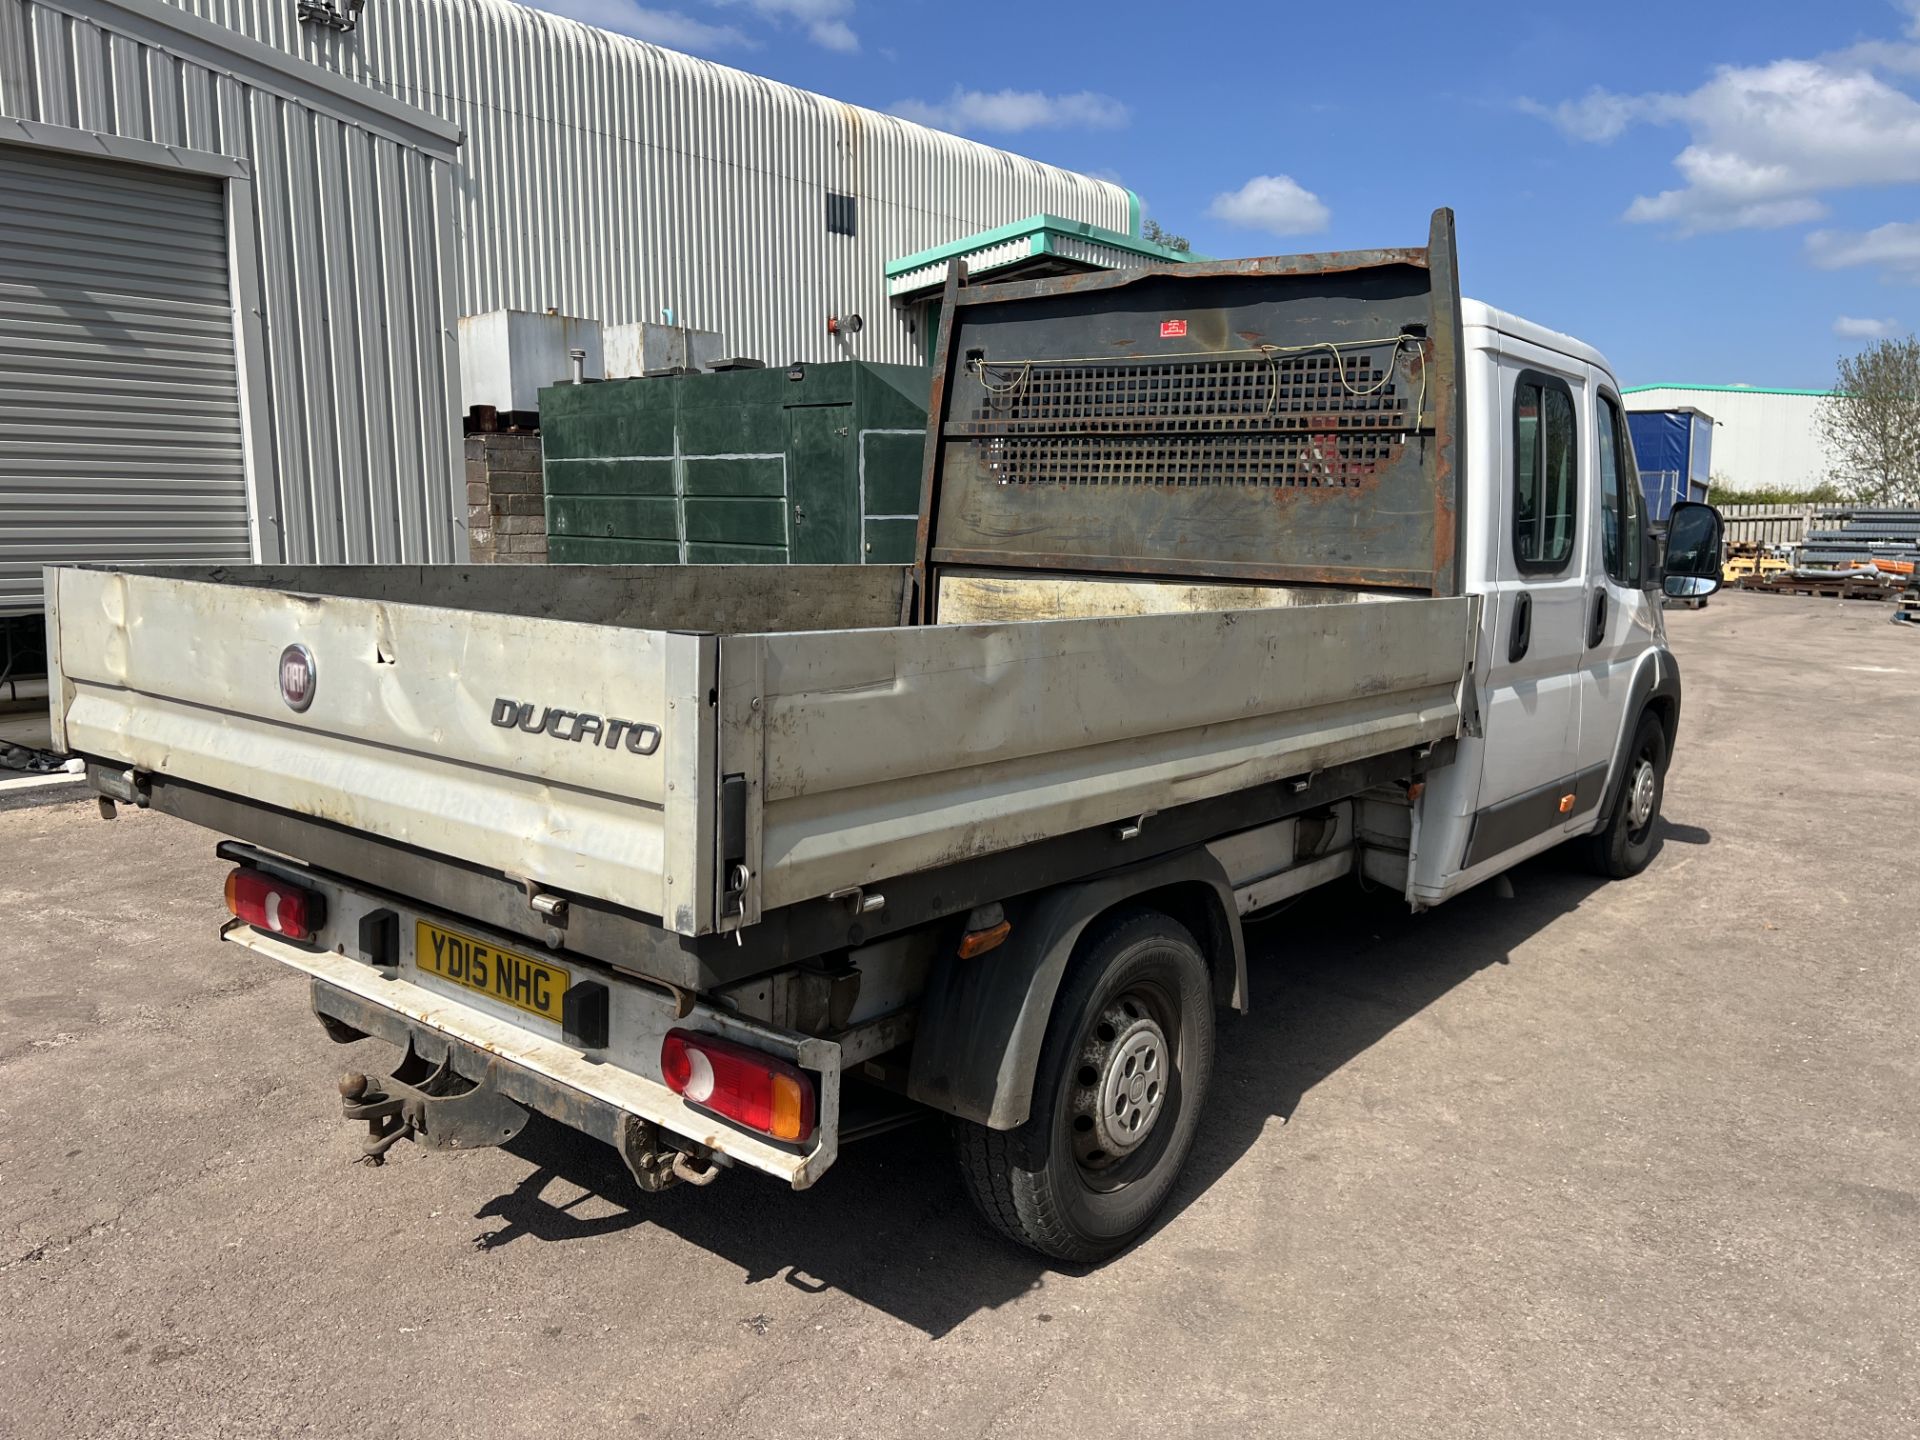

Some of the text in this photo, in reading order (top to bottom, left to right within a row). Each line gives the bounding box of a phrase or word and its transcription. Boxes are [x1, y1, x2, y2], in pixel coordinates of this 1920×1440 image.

[491, 697, 662, 756] DUCATO
[431, 930, 488, 988] YD15
[496, 953, 550, 1012] NHG
